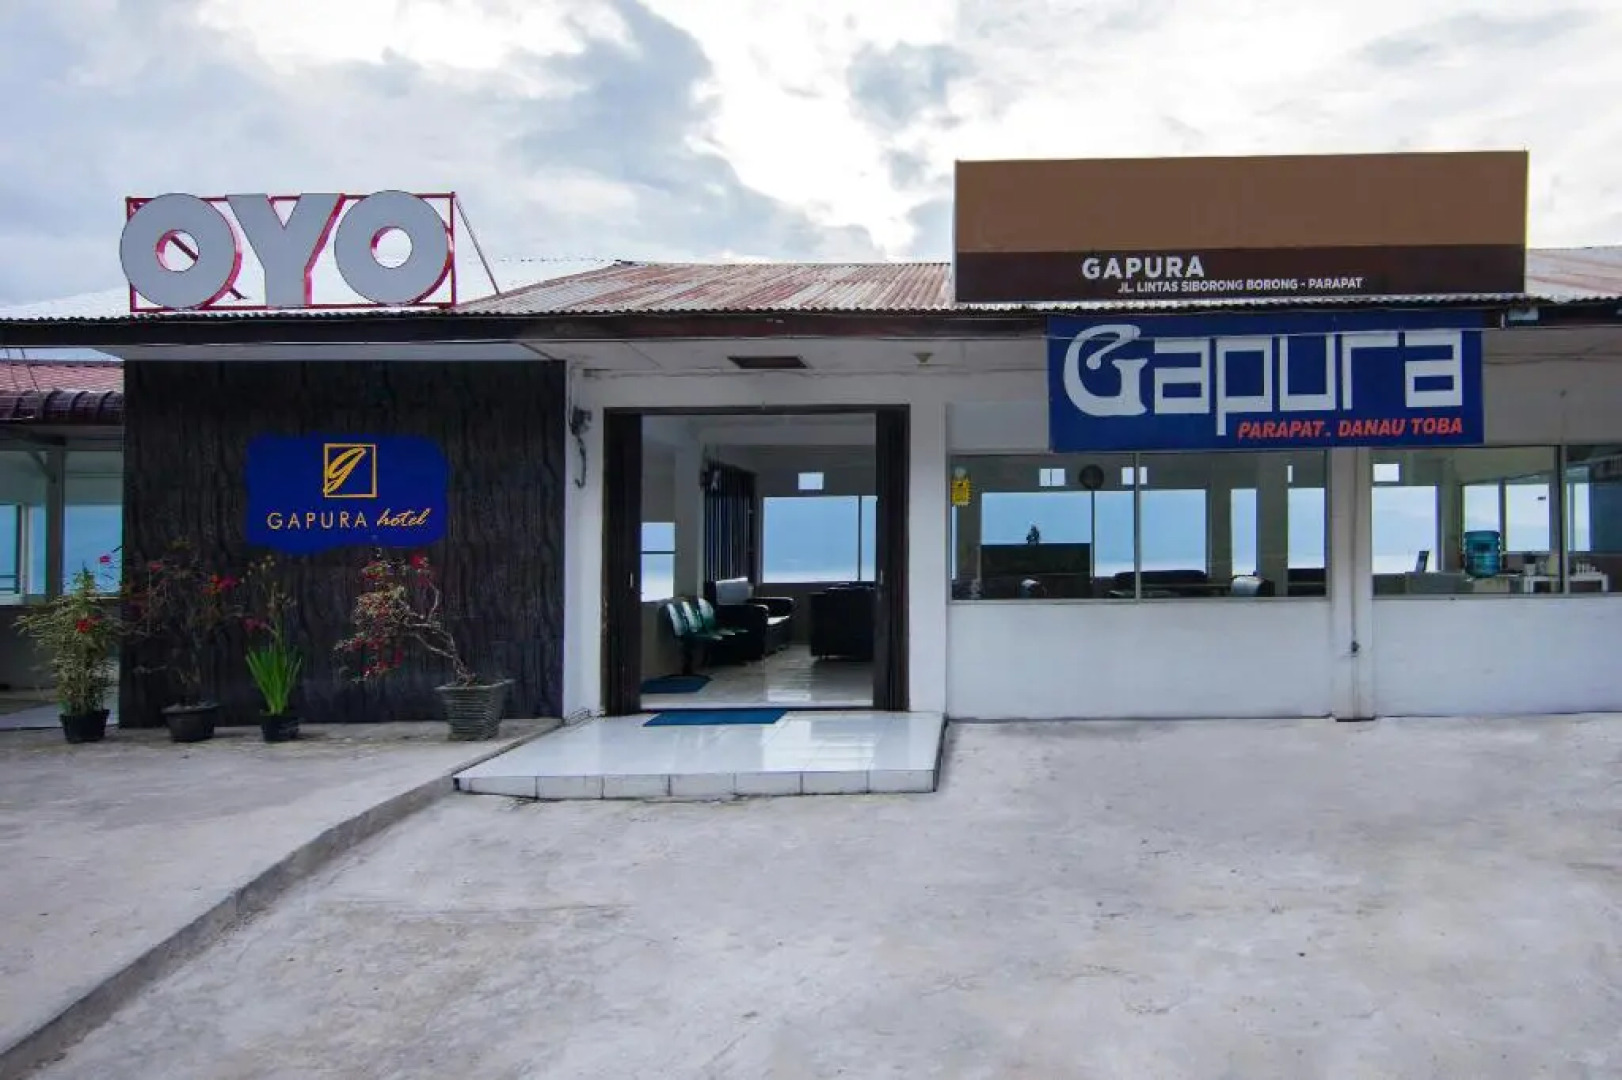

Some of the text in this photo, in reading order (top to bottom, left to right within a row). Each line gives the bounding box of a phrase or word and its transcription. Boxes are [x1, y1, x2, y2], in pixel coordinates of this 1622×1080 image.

[120, 190, 452, 309] OYO
[1082, 255, 1205, 280] GAPURA
[1137, 281, 1179, 293] LINTAS
[1181, 280, 1244, 292] SIBORONG
[1246, 279, 1298, 291] BORONG
[1308, 277, 1363, 290] PARAPAT
[1063, 324, 1463, 436] Gapura
[1338, 418, 1406, 437] DANAU
[1411, 417, 1463, 435] TOBA
[266, 507, 431, 530] GAPURA hotel
